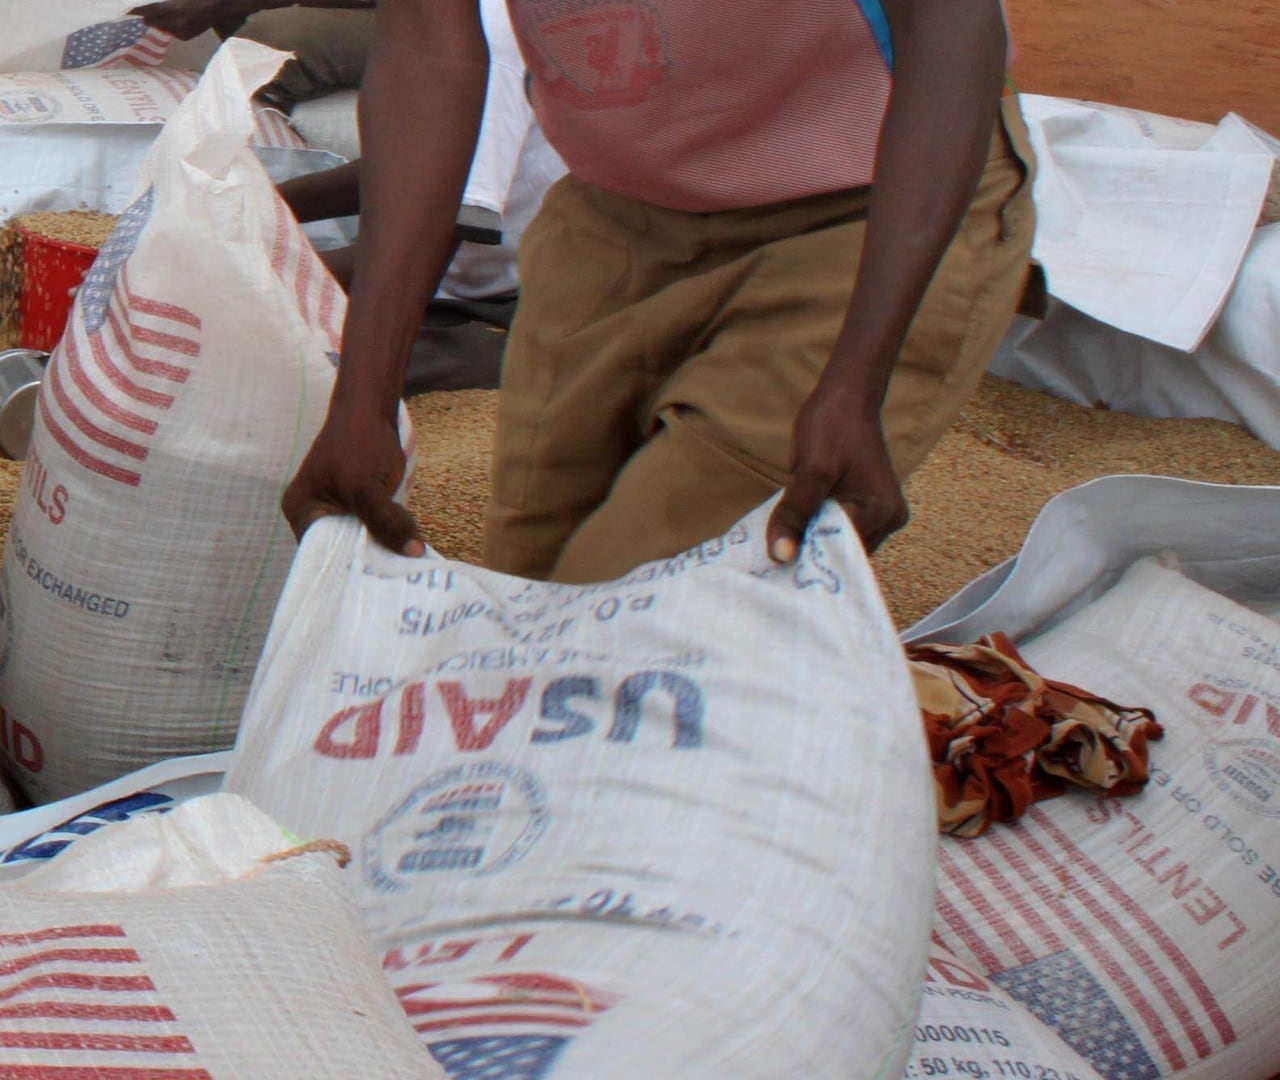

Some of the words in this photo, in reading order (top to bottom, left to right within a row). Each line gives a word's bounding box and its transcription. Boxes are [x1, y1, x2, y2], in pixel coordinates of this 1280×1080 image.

[26, 558, 131, 620] EXCHANGED
[313, 670, 706, 760] USAID
[1170, 785, 1202, 813] OR
[1202, 813, 1260, 866] SOLD
[1085, 797, 1248, 952] LENTILS
[919, 1056, 949, 1075] 50
